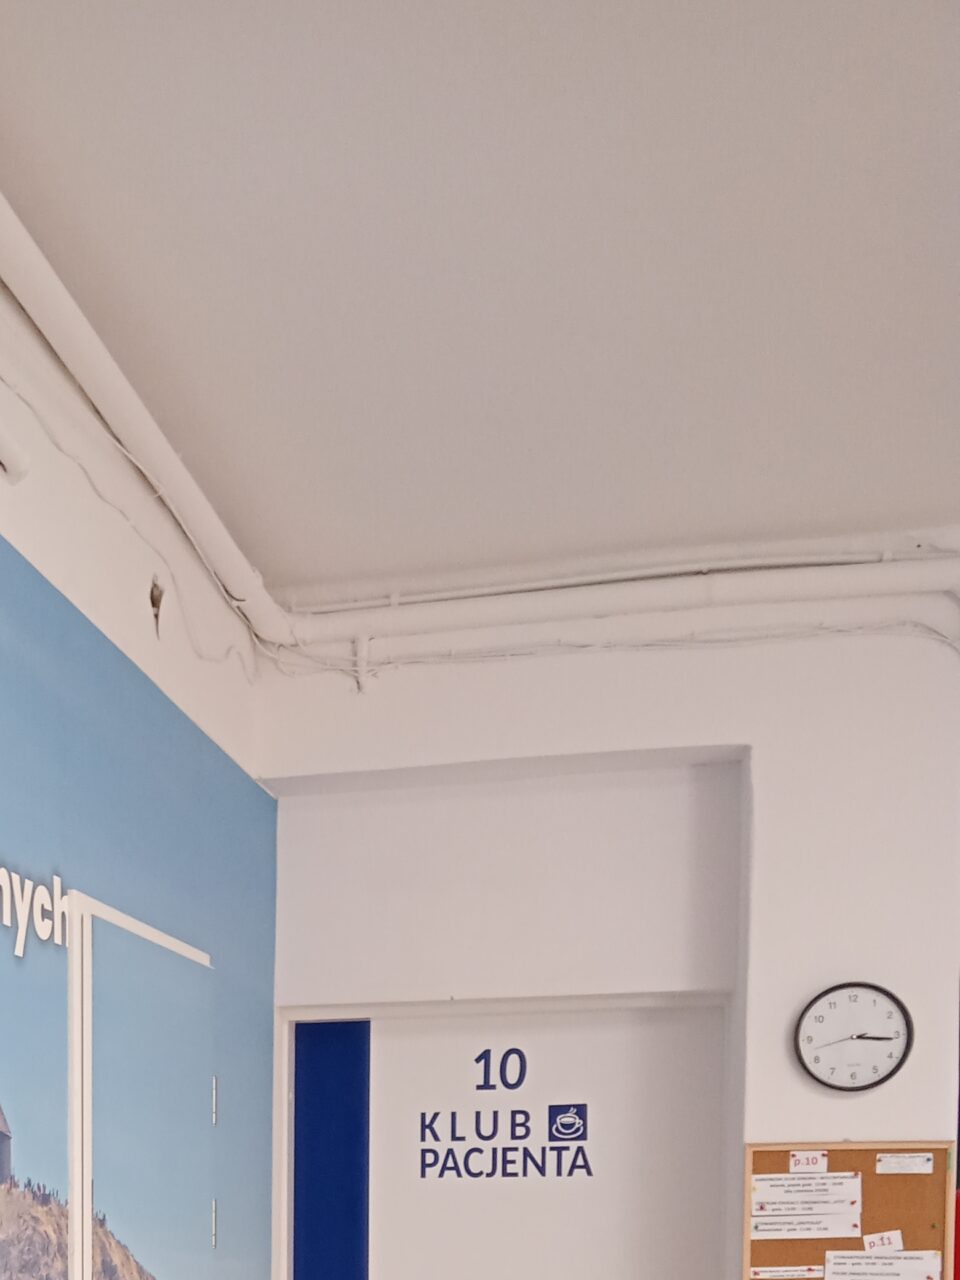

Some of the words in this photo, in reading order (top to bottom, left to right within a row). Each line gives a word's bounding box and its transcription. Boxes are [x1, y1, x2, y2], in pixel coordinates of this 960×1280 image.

[848, 994, 858, 1003] 12
[828, 1001, 837, 1009] 11
[872, 999, 877, 1007] 1
[814, 1015, 824, 1023] 10
[886, 1011, 893, 1019] 2
[894, 1031, 900, 1039] 3
[806, 1035, 813, 1044] 9
[814, 1056, 820, 1064] 8
[474, 1047, 527, 1090] 10
[829, 1067, 836, 1075] 7
[872, 1066, 878, 1074] 5
[850, 1072, 857, 1080] 6
[420, 1110, 531, 1142] KLUB
[420, 1146, 593, 1178] PACJENTA
[793, 1156, 818, 1166] p.10
